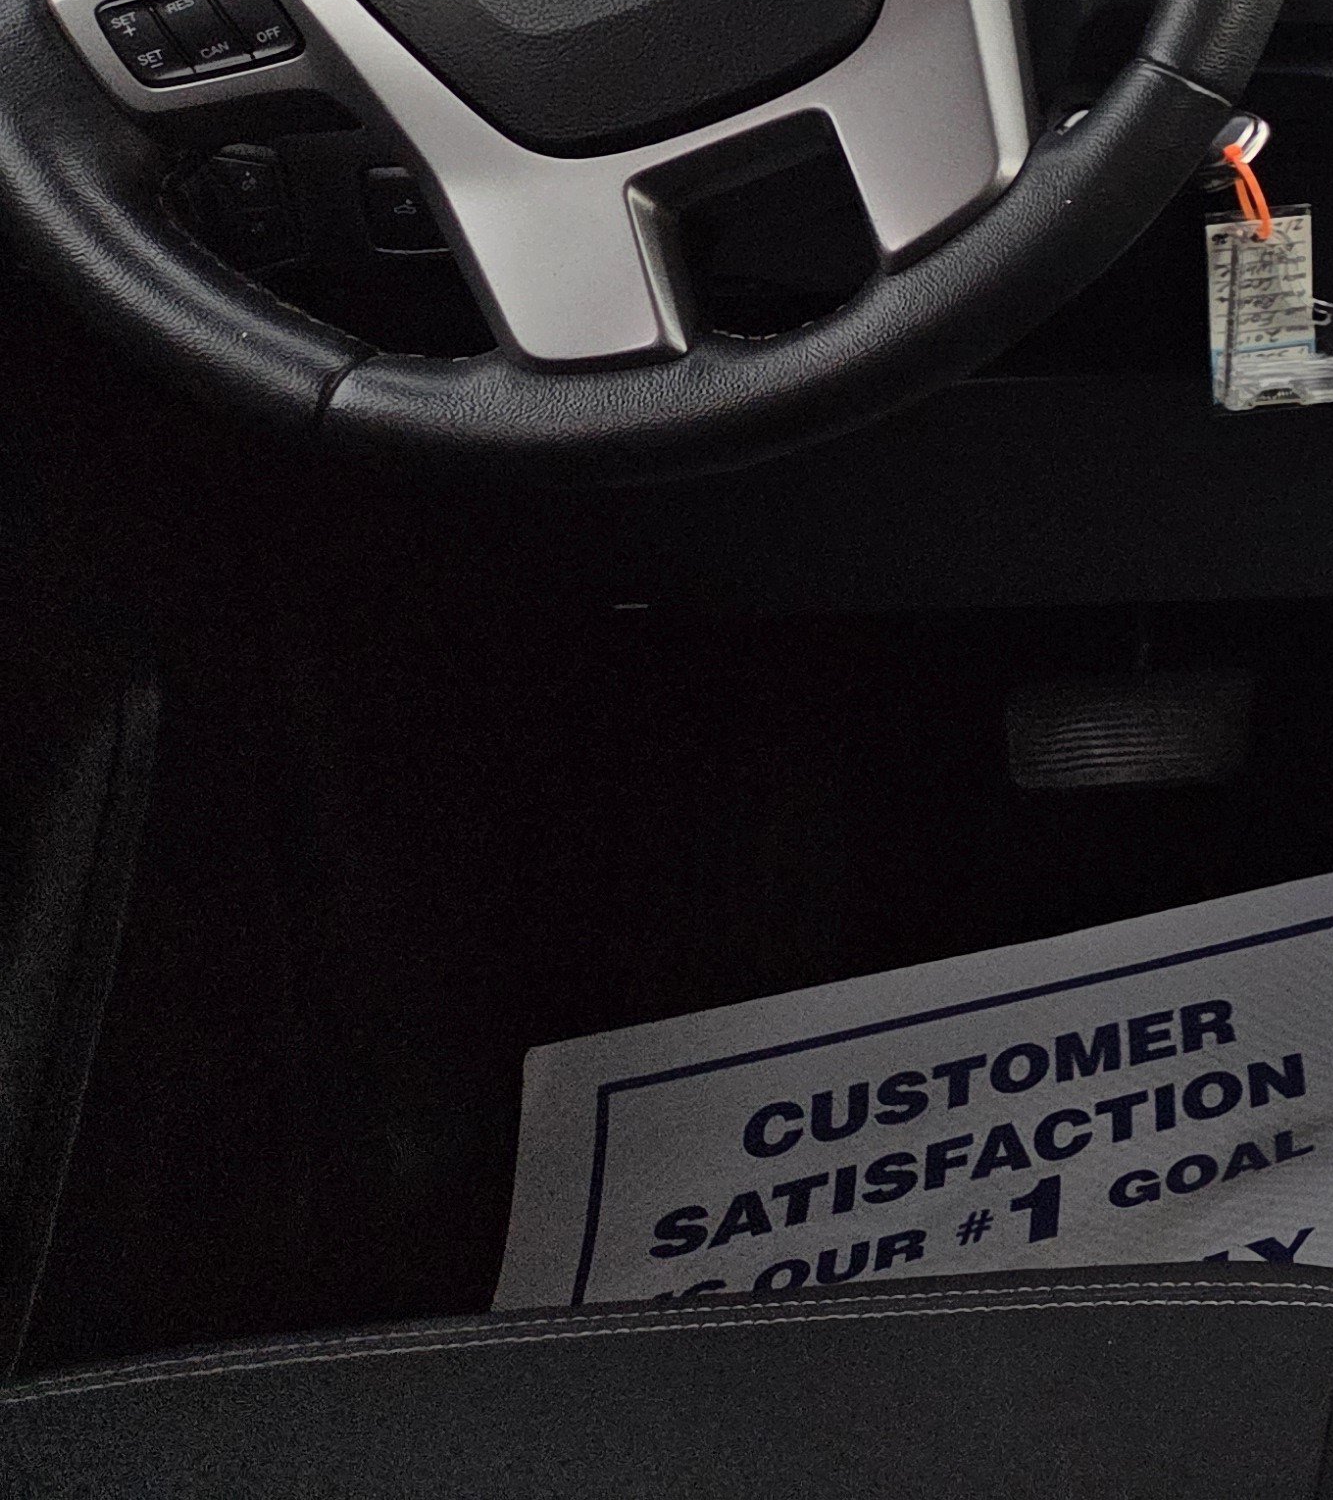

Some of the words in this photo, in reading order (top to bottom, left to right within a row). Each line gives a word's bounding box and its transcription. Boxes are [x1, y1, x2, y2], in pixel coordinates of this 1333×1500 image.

[110, 11, 136, 29] SET
[256, 26, 281, 44] OFF
[137, 49, 163, 66] SET
[200, 40, 229, 59] CAN
[742, 998, 1236, 1160] CUSTOMER
[648, 1053, 1308, 1259] SATISFACTION
[752, 1228, 927, 1300] OUR
[957, 1174, 1062, 1246] #1
[1107, 1129, 1315, 1208] GOAL
